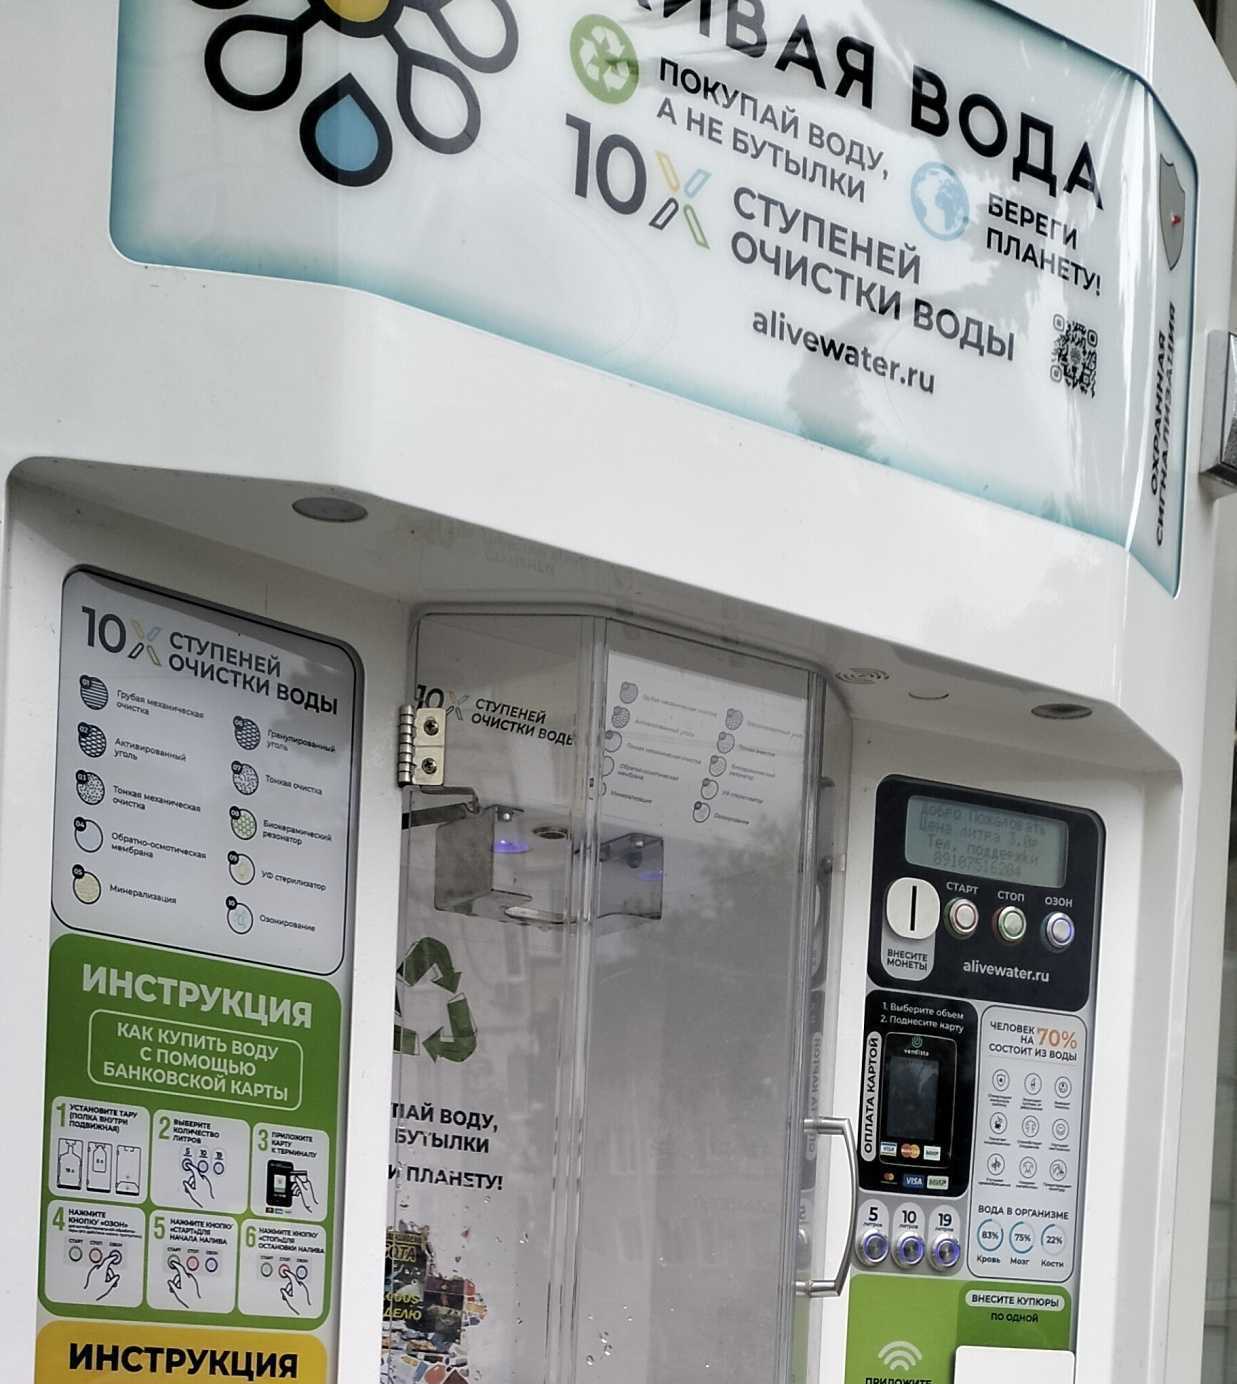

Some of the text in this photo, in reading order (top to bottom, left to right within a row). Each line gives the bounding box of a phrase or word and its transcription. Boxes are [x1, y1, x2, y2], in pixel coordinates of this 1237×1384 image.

[660, 57, 888, 181] ПОКУПАЙ ВОДУ,
[911, 65, 1104, 211] ВОДА
[656, 97, 865, 203] А НЕ БУТЫЛКИ
[988, 193, 1078, 251] БЕРЕГИ
[733, 186, 921, 285] СТУПЕНЕЙ
[986, 227, 1101, 296] ПЛАНЕТУ!
[731, 231, 1015, 361] ОЧИСТКИ ВОДЫ
[752, 310, 936, 395] alivewater.ru
[1150, 330, 1166, 496] ОХРАННАЯ
[1155, 302, 1176, 547] СИГНАЛИЗАЦИЯ
[169, 631, 281, 678] СТУПЕНЕЙ
[168, 654, 338, 715] ОЧИСТКИ ВОДЫ
[116, 689, 146, 703] Грубая
[116, 701, 149, 715] очистка
[475, 698, 546, 724] СТУПЕНЕЙ
[471, 713, 535, 737] ОЧИСТКИ
[113, 749, 138, 761] уголь
[115, 738, 186, 762] Активированный
[112, 797, 146, 810] очистка
[113, 785, 201, 813] Тонкая механическая
[111, 832, 207, 859] Обратно-осмотическая
[111, 844, 154, 858] мембрана
[110, 884, 177, 905] Минерализация
[946, 881, 979, 895] СТАРТ
[997, 890, 1025, 902] СТОП
[1044, 895, 1073, 908] ОЗОН
[260, 914, 316, 932] Озонирование
[886, 958, 928, 971] МОНЕТЫ
[887, 949, 928, 962] ВНЕСИТЕ
[962, 960, 1050, 983] alivewater.ru
[82, 962, 313, 1029] ИНСТРУКЦИЯ
[890, 1002, 964, 1019] Выберите объем
[889, 1015, 939, 1028] Поднесите
[940, 1022, 965, 1034] карту
[990, 1021, 1035, 1034] ЧЕЛОВЕК
[117, 1021, 279, 1061] КАК КУПИТЬ ВОДУ
[1020, 1027, 1078, 1049] НА 70%
[988, 1043, 1077, 1061] СОСТОИТ ИЗ ВОДЫ
[139, 1046, 256, 1077] С ПОМОЩЬЮ
[103, 1061, 288, 1101] БАНКОВСКОЙ КАРТЫ
[863, 1037, 879, 1153] ОПЛАТА КАРТОЙ
[56, 1103, 66, 1127] 1
[69, 1103, 138, 1119] УСТАНОВИТЕ ТАРУ
[99, 1115, 129, 1125] ВНУТРИ
[159, 1116, 171, 1140] 2
[173, 1118, 212, 1130] ВЫБЕРИТЕ
[440, 1108, 499, 1133] ВОДУ,
[172, 1135, 202, 1144] ЛИТРОВ
[173, 1127, 220, 1139] КОЛИЧЕСТВО
[257, 1129, 268, 1151] 3
[271, 1131, 313, 1143] ПРИЛОЖИТЕ
[906, 1177, 922, 1185] VISA
[52, 1206, 65, 1231] 4
[68, 1208, 106, 1218] НАЖМИТЕ
[868, 1206, 879, 1221] 5
[902, 1210, 917, 1224] 10
[938, 1213, 952, 1227] 19
[978, 1204, 1069, 1220] ВОДА В ОРГАНИЗМЕ
[154, 1216, 165, 1240] 5
[170, 1218, 205, 1228] НАЖМИТЕ
[169, 1234, 199, 1242] НАЧАЛА
[245, 1226, 256, 1248] 6
[982, 1230, 999, 1240] 83%
[1014, 1233, 1031, 1242] 75%
[1045, 1236, 1063, 1245] 22%
[976, 1255, 1001, 1265] Кровь
[1010, 1257, 1030, 1265] Мозг
[1041, 1259, 1064, 1268] Кости
[971, 1294, 1060, 1307] ВНЕСИТЕ КУПЮРЫ
[990, 1312, 1039, 1323] ПО ОДНОЙ
[69, 1342, 298, 1382] ИНСТРУКЦИЯ
